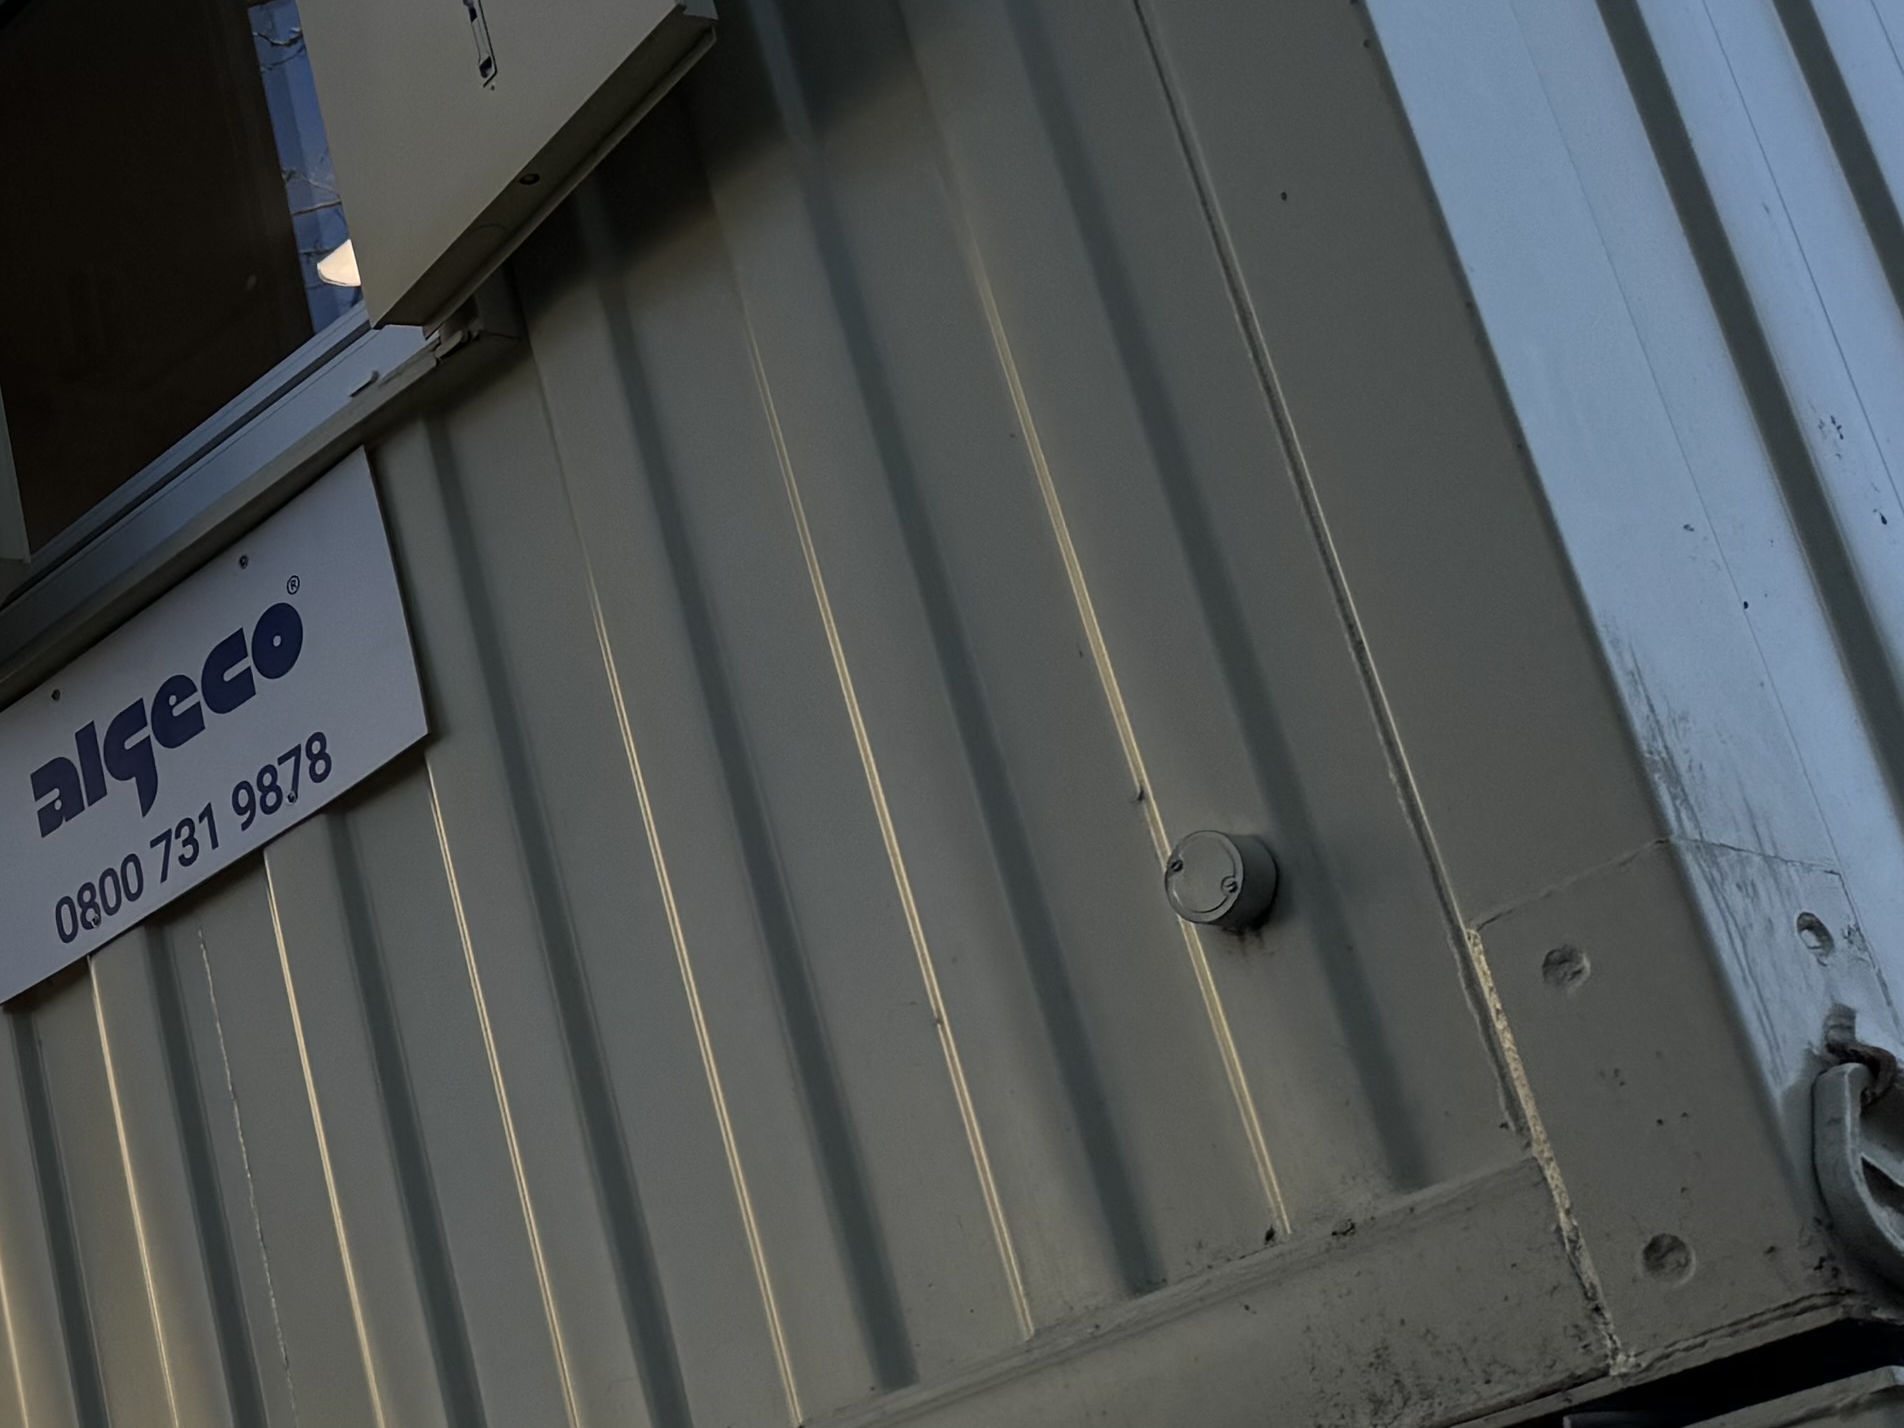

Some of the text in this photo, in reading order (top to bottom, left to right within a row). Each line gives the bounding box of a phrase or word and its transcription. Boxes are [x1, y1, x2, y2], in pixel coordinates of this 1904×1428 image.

[55, 731, 333, 944] 0800 731 9878
